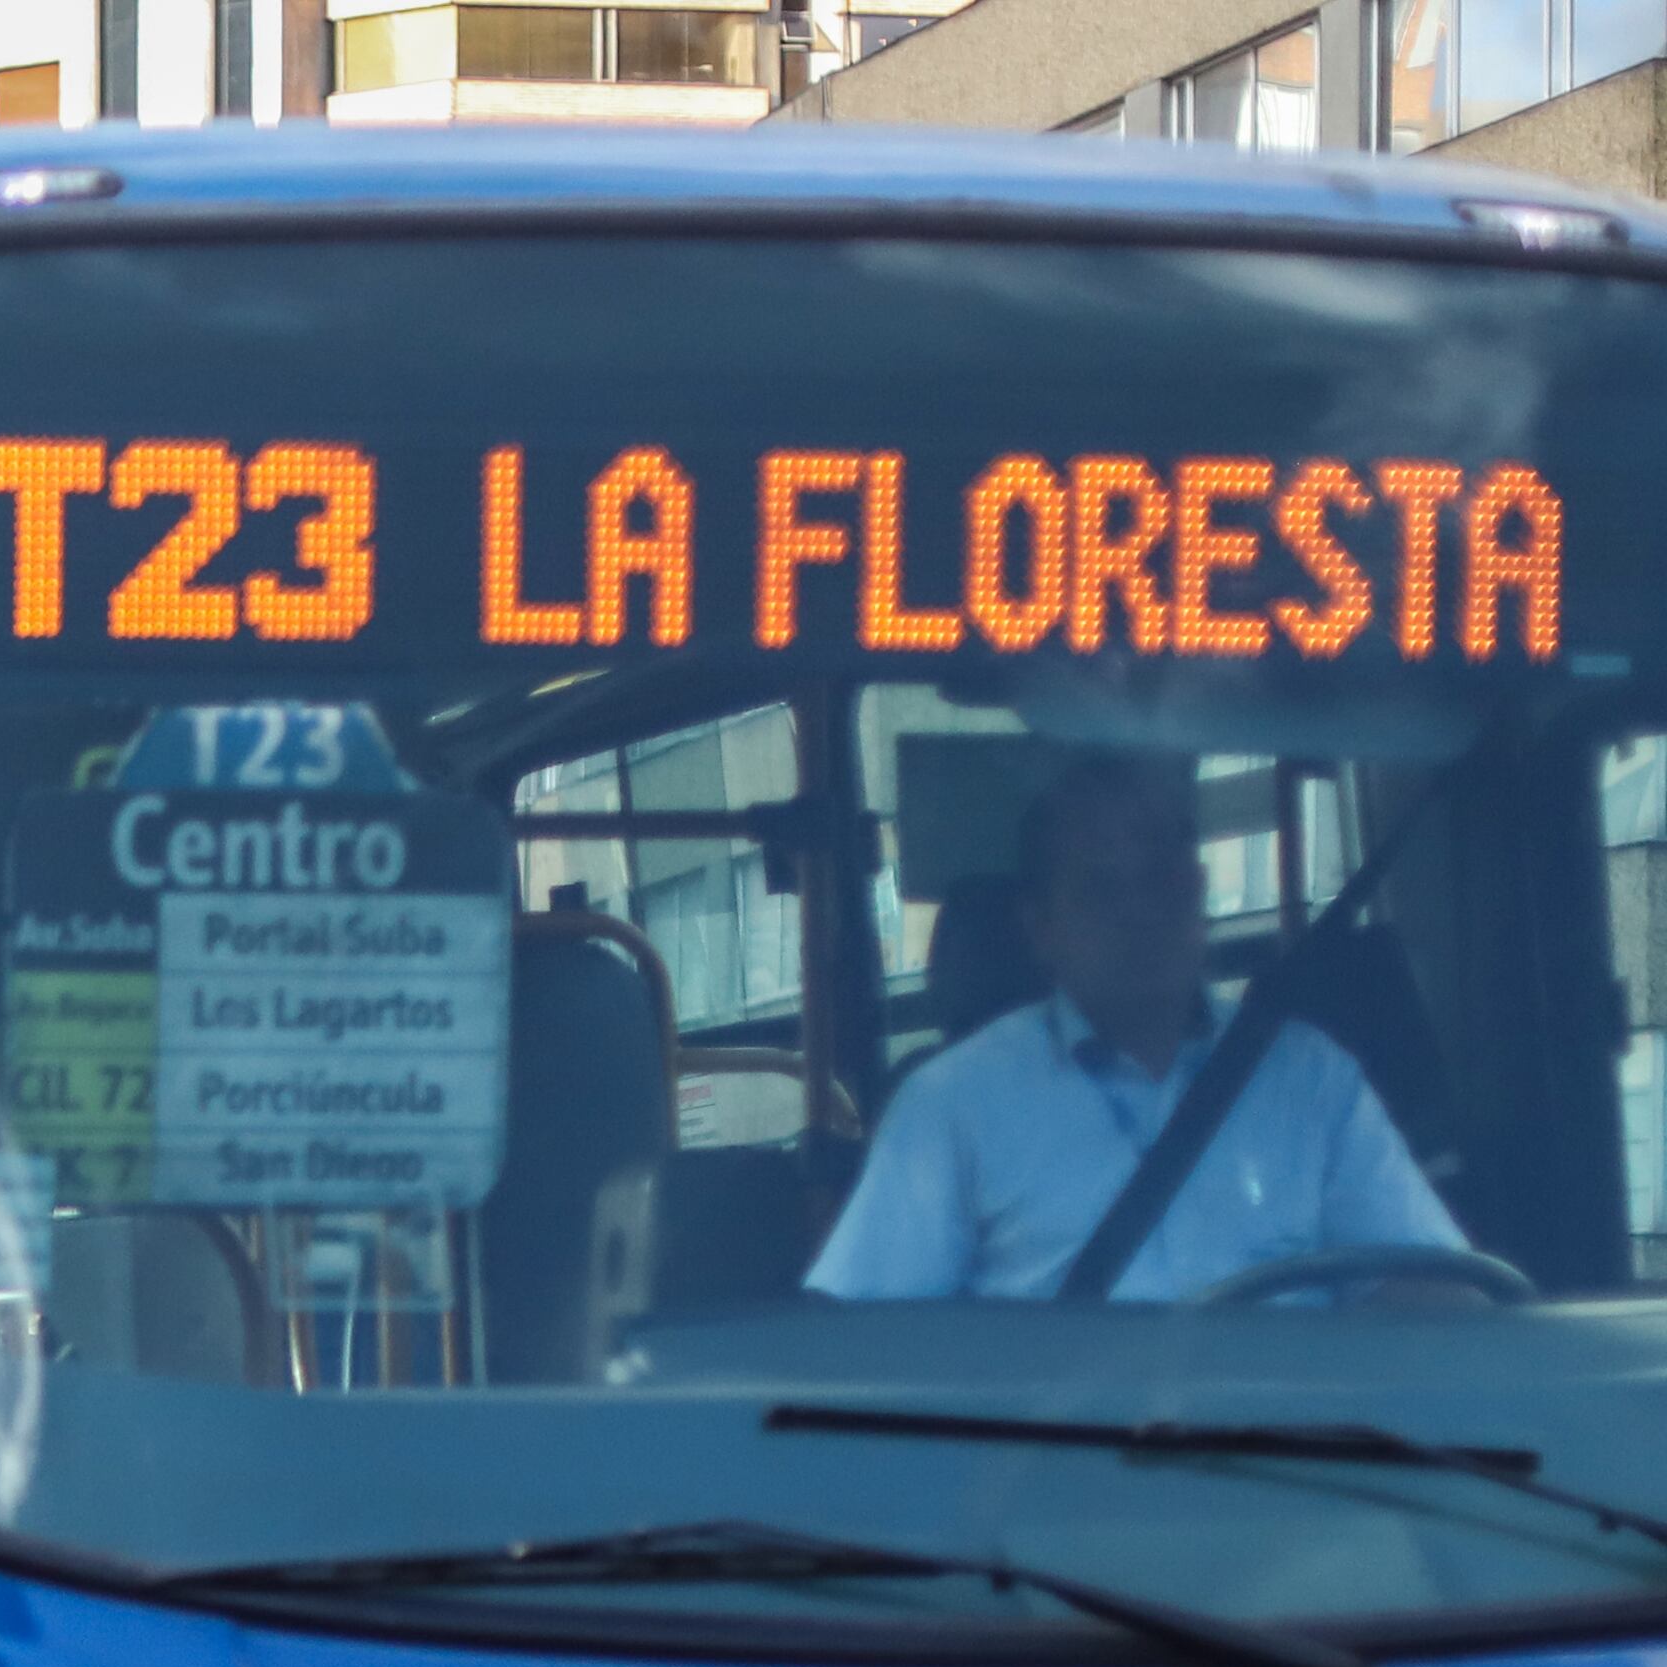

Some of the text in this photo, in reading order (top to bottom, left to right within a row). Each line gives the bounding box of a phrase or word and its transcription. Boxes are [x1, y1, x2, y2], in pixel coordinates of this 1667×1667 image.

[479, 444, 694, 649] LA
[754, 449, 1566, 663] FLORESTA
[190, 704, 345, 787] T23
[110, 794, 408, 888] Centro
[204, 912, 448, 956] Portal Suba
[191, 987, 261, 1032] Los
[274, 988, 455, 1042] Lagartos
[99, 1065, 154, 1112] 72
[197, 1068, 446, 1114] Porciúncula
[218, 1140, 292, 1182] San
